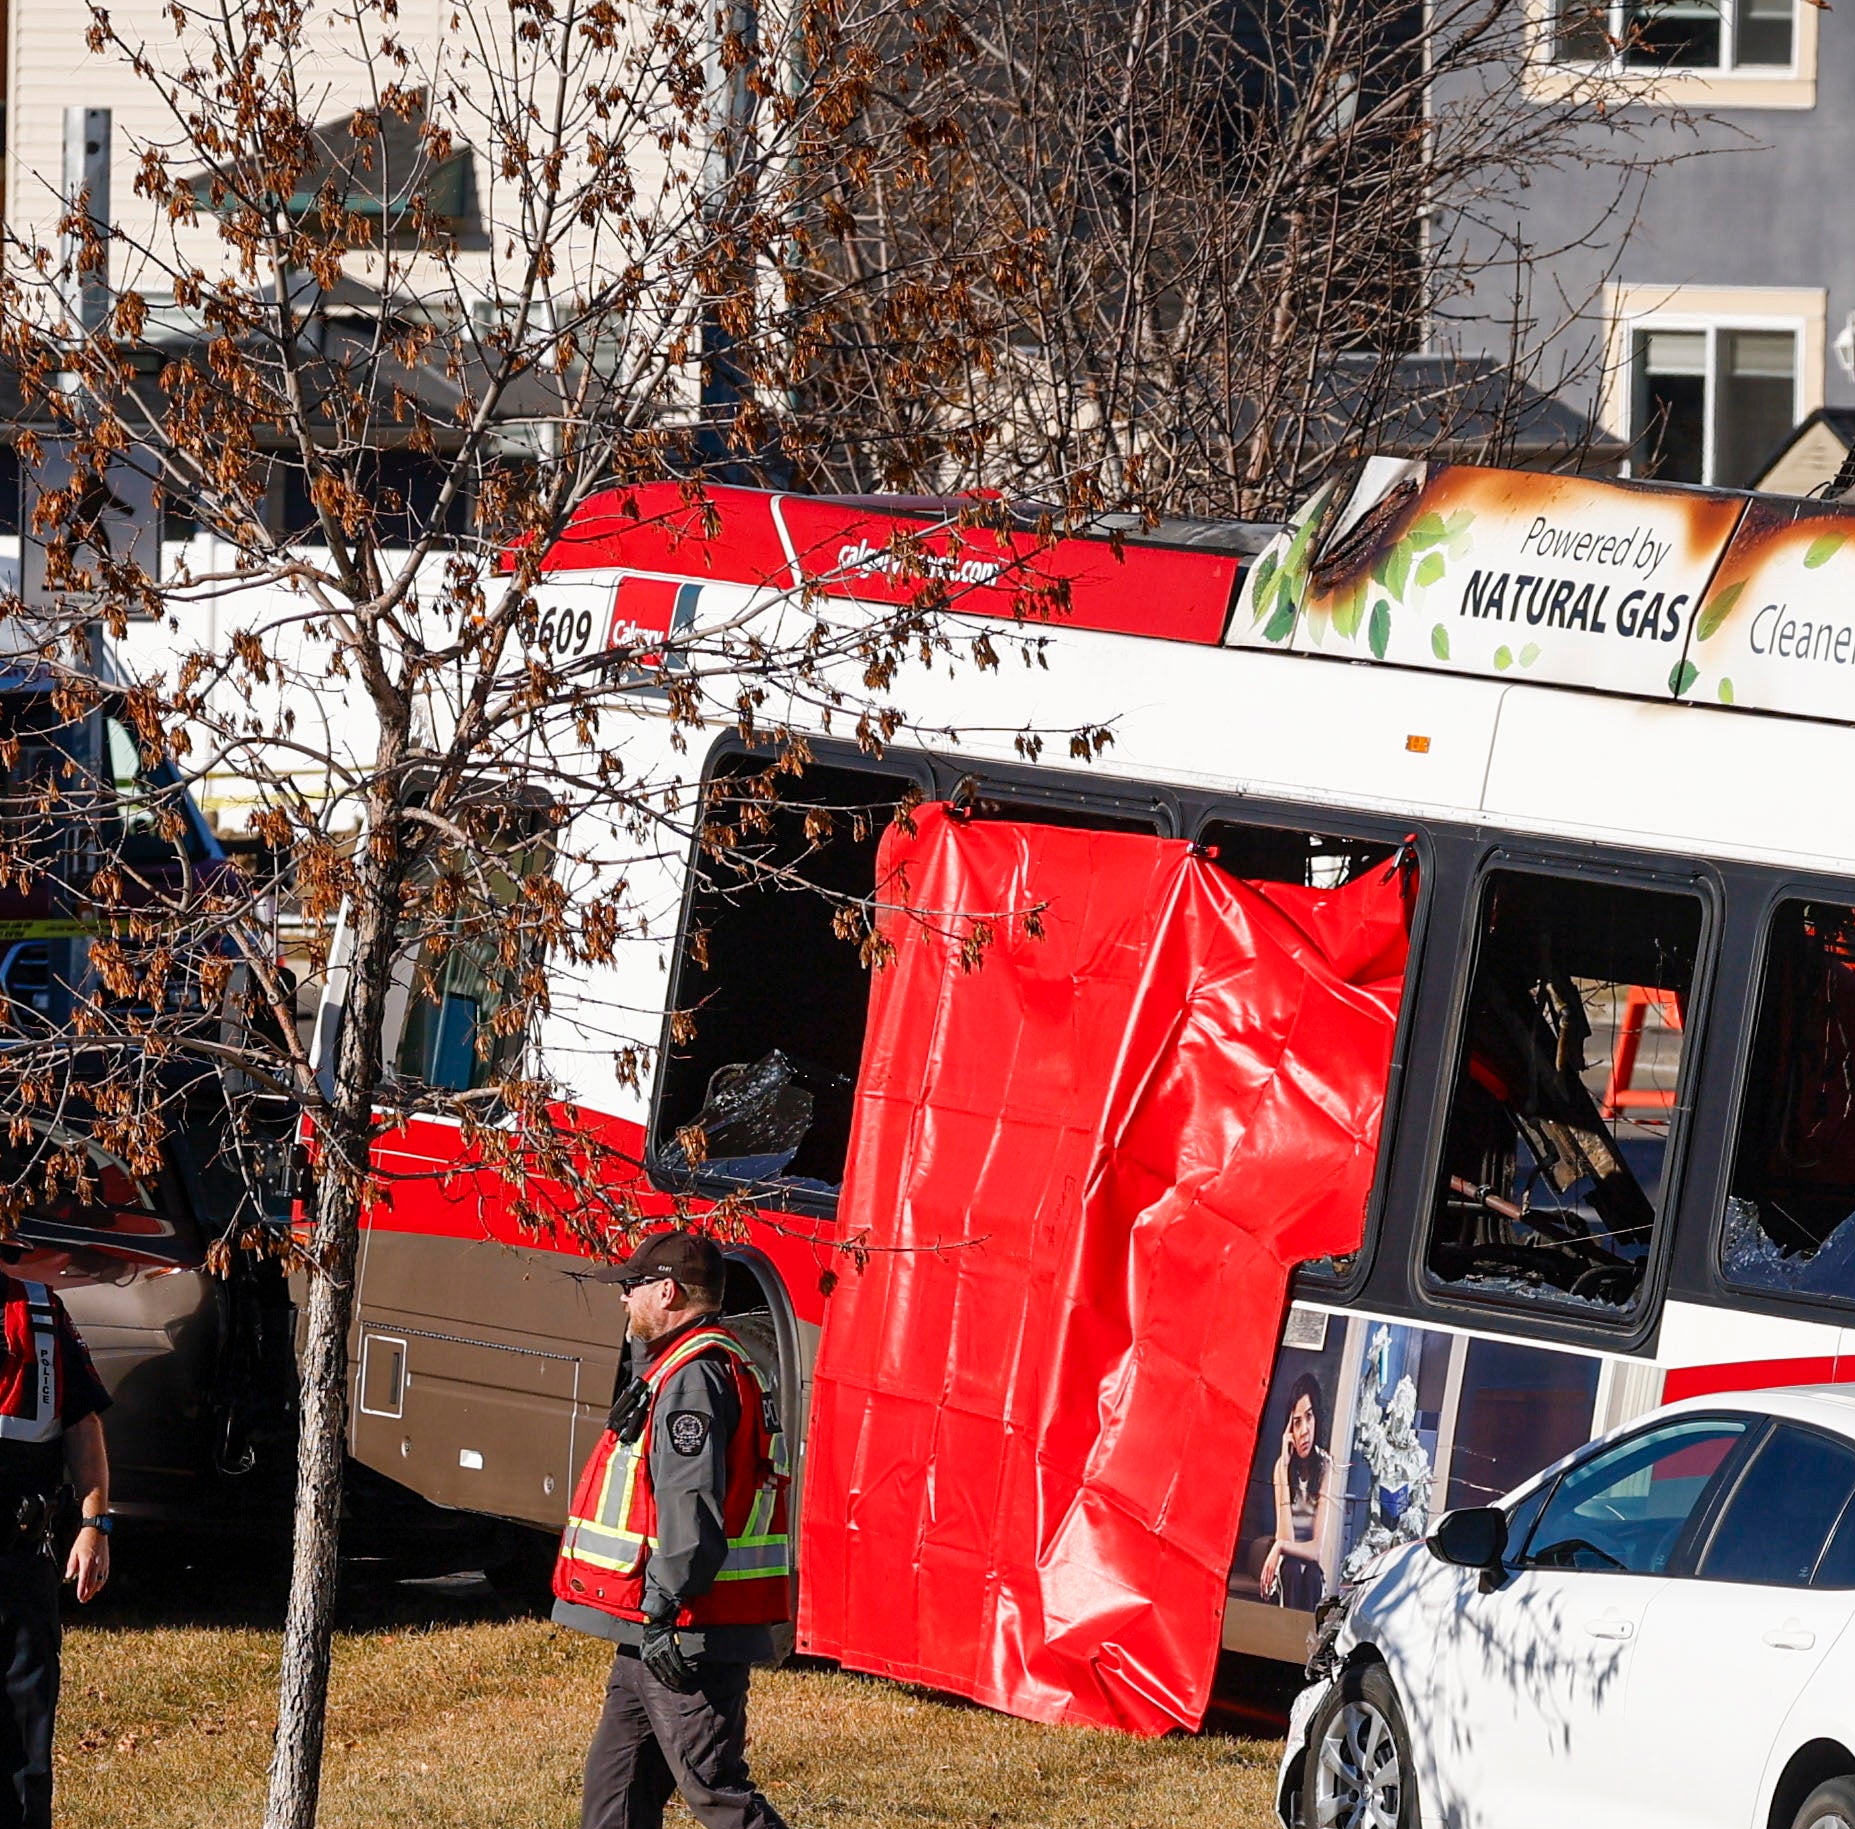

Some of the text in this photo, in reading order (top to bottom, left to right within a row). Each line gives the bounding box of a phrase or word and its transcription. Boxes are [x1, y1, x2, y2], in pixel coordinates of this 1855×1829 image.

[1520, 516, 1672, 581] Powered by
[1460, 569, 1690, 643] NATURAL GAS
[40, 1349, 51, 1405] POLICE
